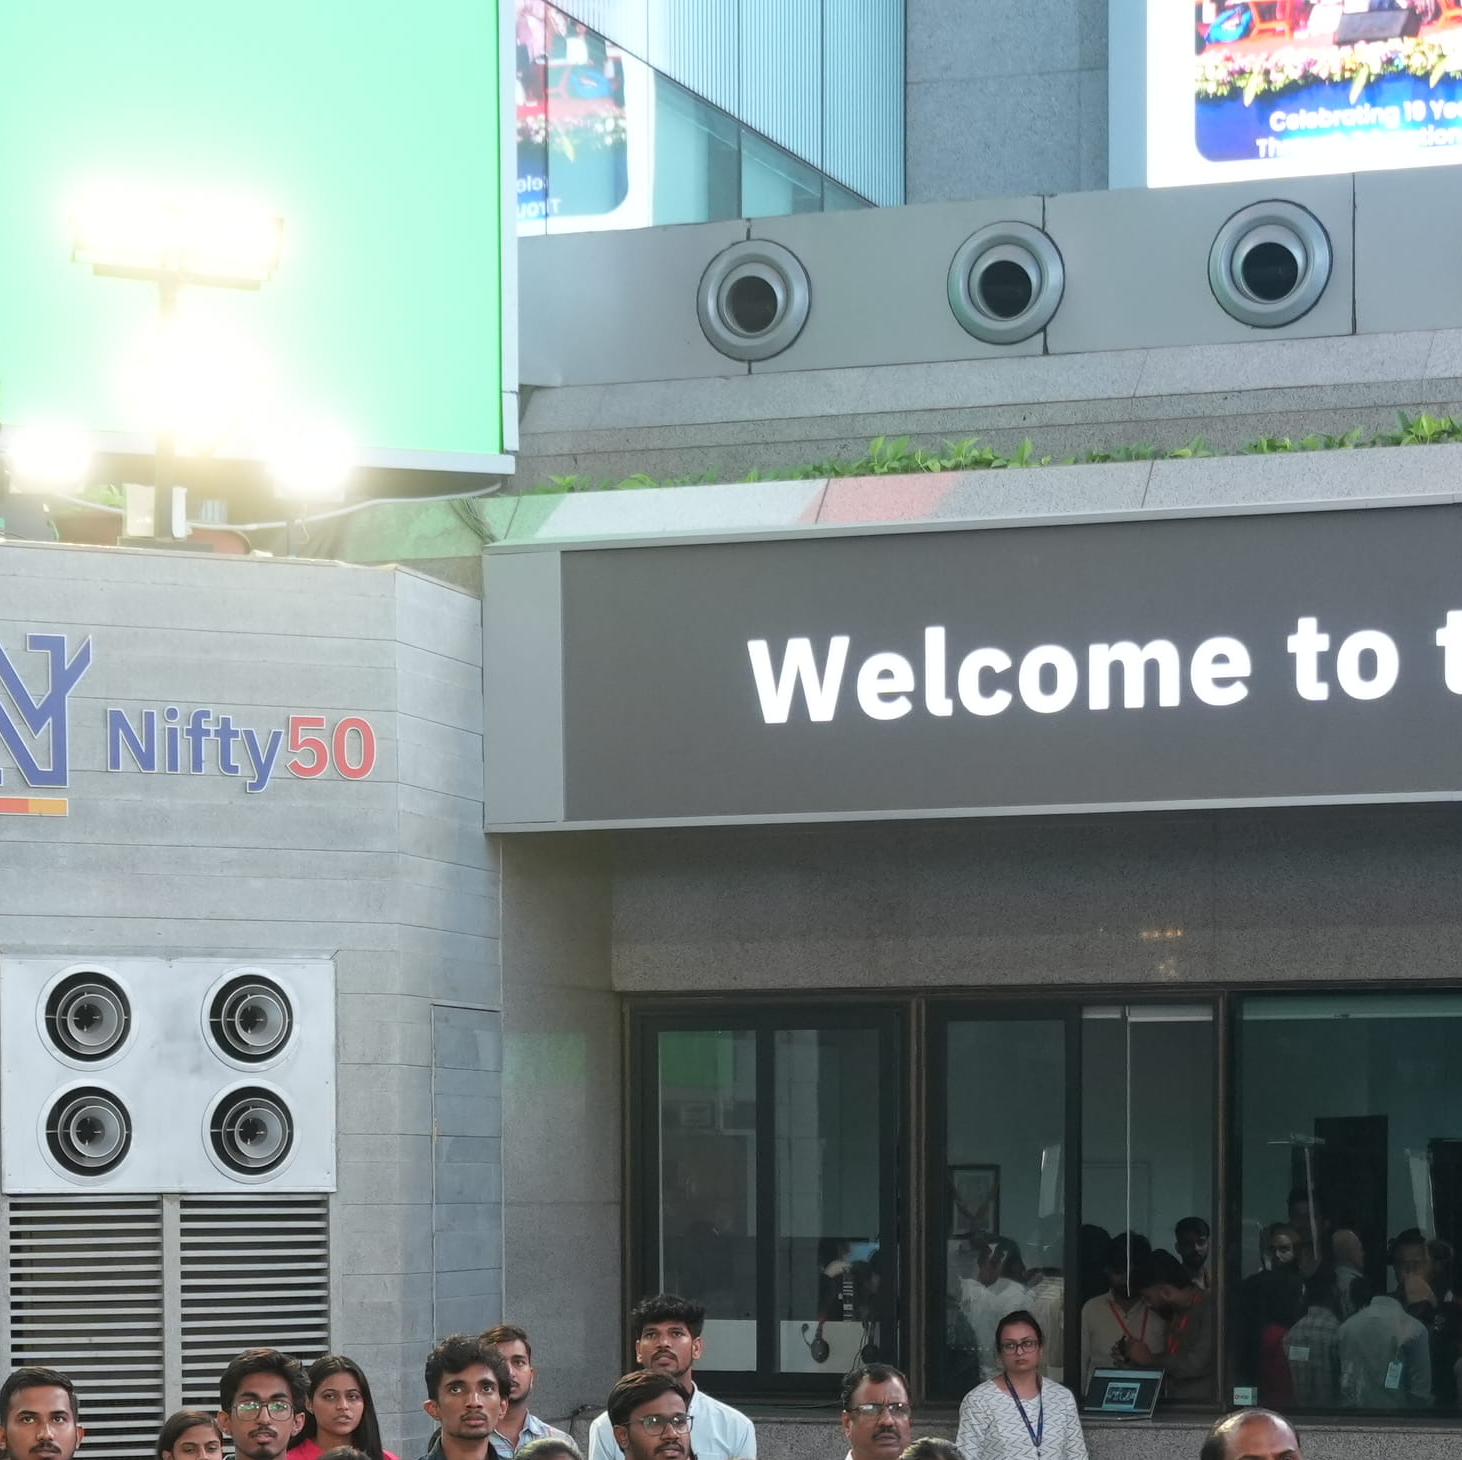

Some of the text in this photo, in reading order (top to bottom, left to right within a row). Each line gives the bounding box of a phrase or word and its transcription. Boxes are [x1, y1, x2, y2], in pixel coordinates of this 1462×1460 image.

[1269, 103, 1400, 132] Celebrating
[746, 623, 1252, 726] Welcome
[1286, 614, 1401, 703] to
[106, 706, 377, 793] Nifty50
